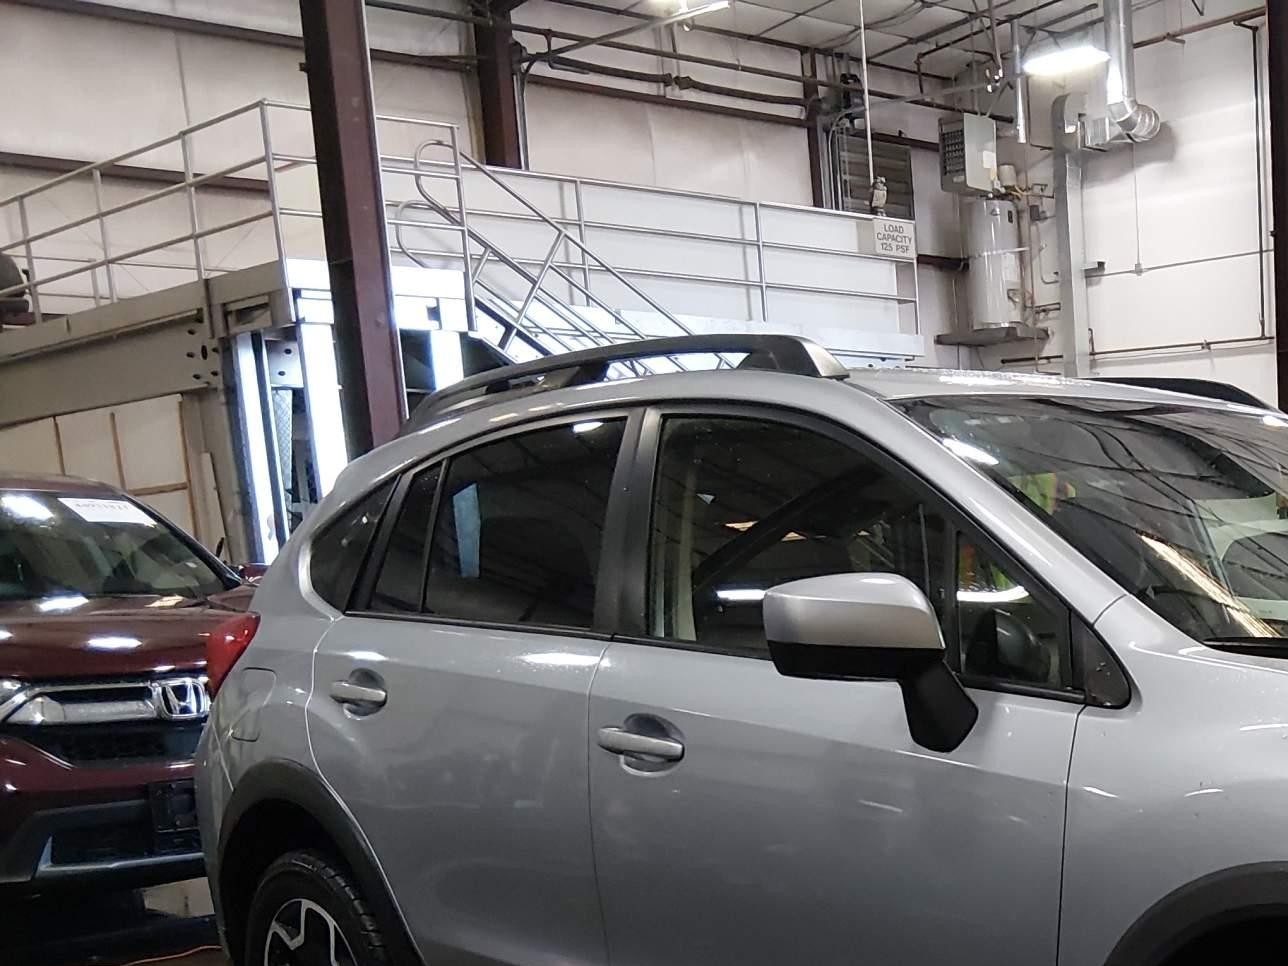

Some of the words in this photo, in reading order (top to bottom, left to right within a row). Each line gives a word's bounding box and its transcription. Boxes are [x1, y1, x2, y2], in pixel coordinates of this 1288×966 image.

[883, 224, 904, 233] LOAD
[876, 232, 912, 244] CAPACITY
[881, 242, 893, 251] 125
[895, 244, 909, 253] PSF
